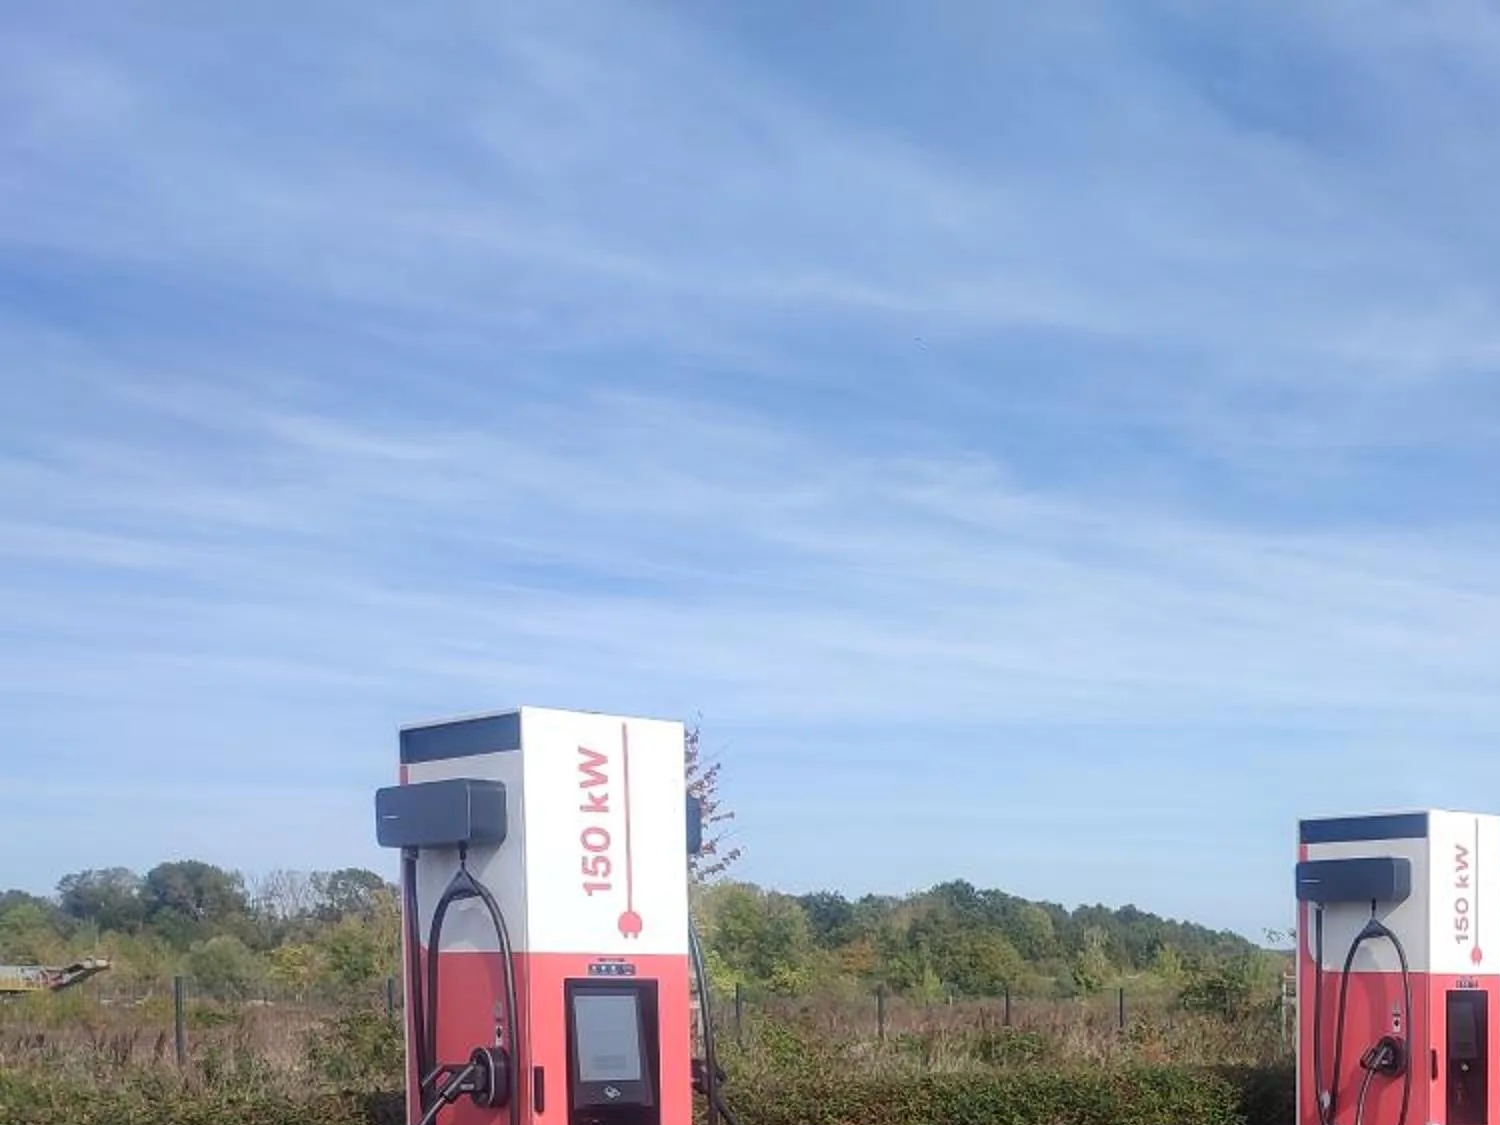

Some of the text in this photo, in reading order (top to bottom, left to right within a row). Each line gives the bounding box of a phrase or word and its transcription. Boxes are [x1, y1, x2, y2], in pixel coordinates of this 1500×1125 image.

[577, 745, 612, 898] 150 kW
[1454, 844, 1470, 945] 150 kW
